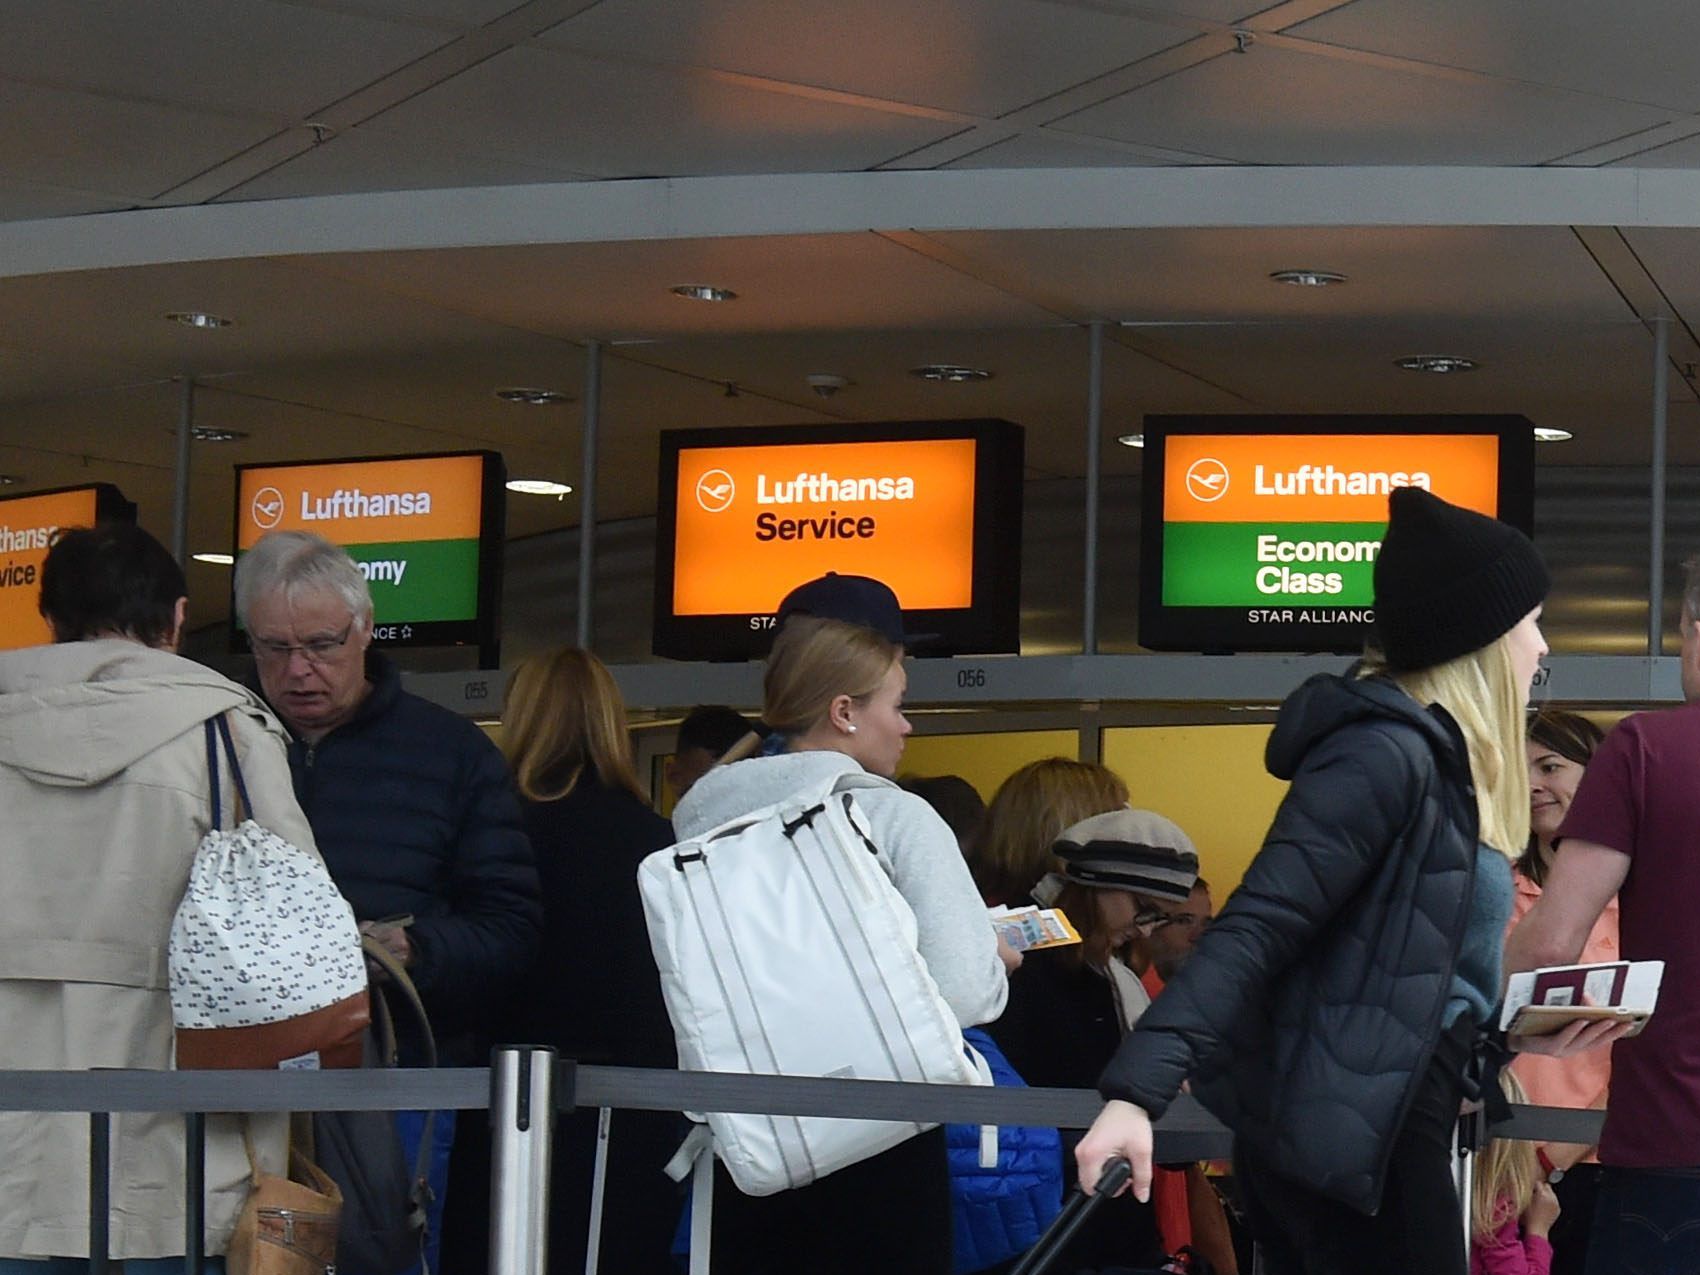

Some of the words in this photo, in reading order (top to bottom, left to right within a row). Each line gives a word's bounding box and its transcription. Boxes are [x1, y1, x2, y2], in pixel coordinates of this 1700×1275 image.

[757, 473, 914, 504] Lufthansa
[1255, 465, 1431, 495] Lufthansa
[301, 489, 430, 520] Lufthansa
[755, 511, 875, 541] Service
[1257, 535, 1380, 562] Econom
[1256, 566, 1342, 594] Class
[750, 616, 777, 630] STA
[1248, 610, 1294, 623] STAR
[1299, 610, 1375, 624] ALLIANC
[464, 682, 488, 700] 055
[957, 669, 986, 688] 056
